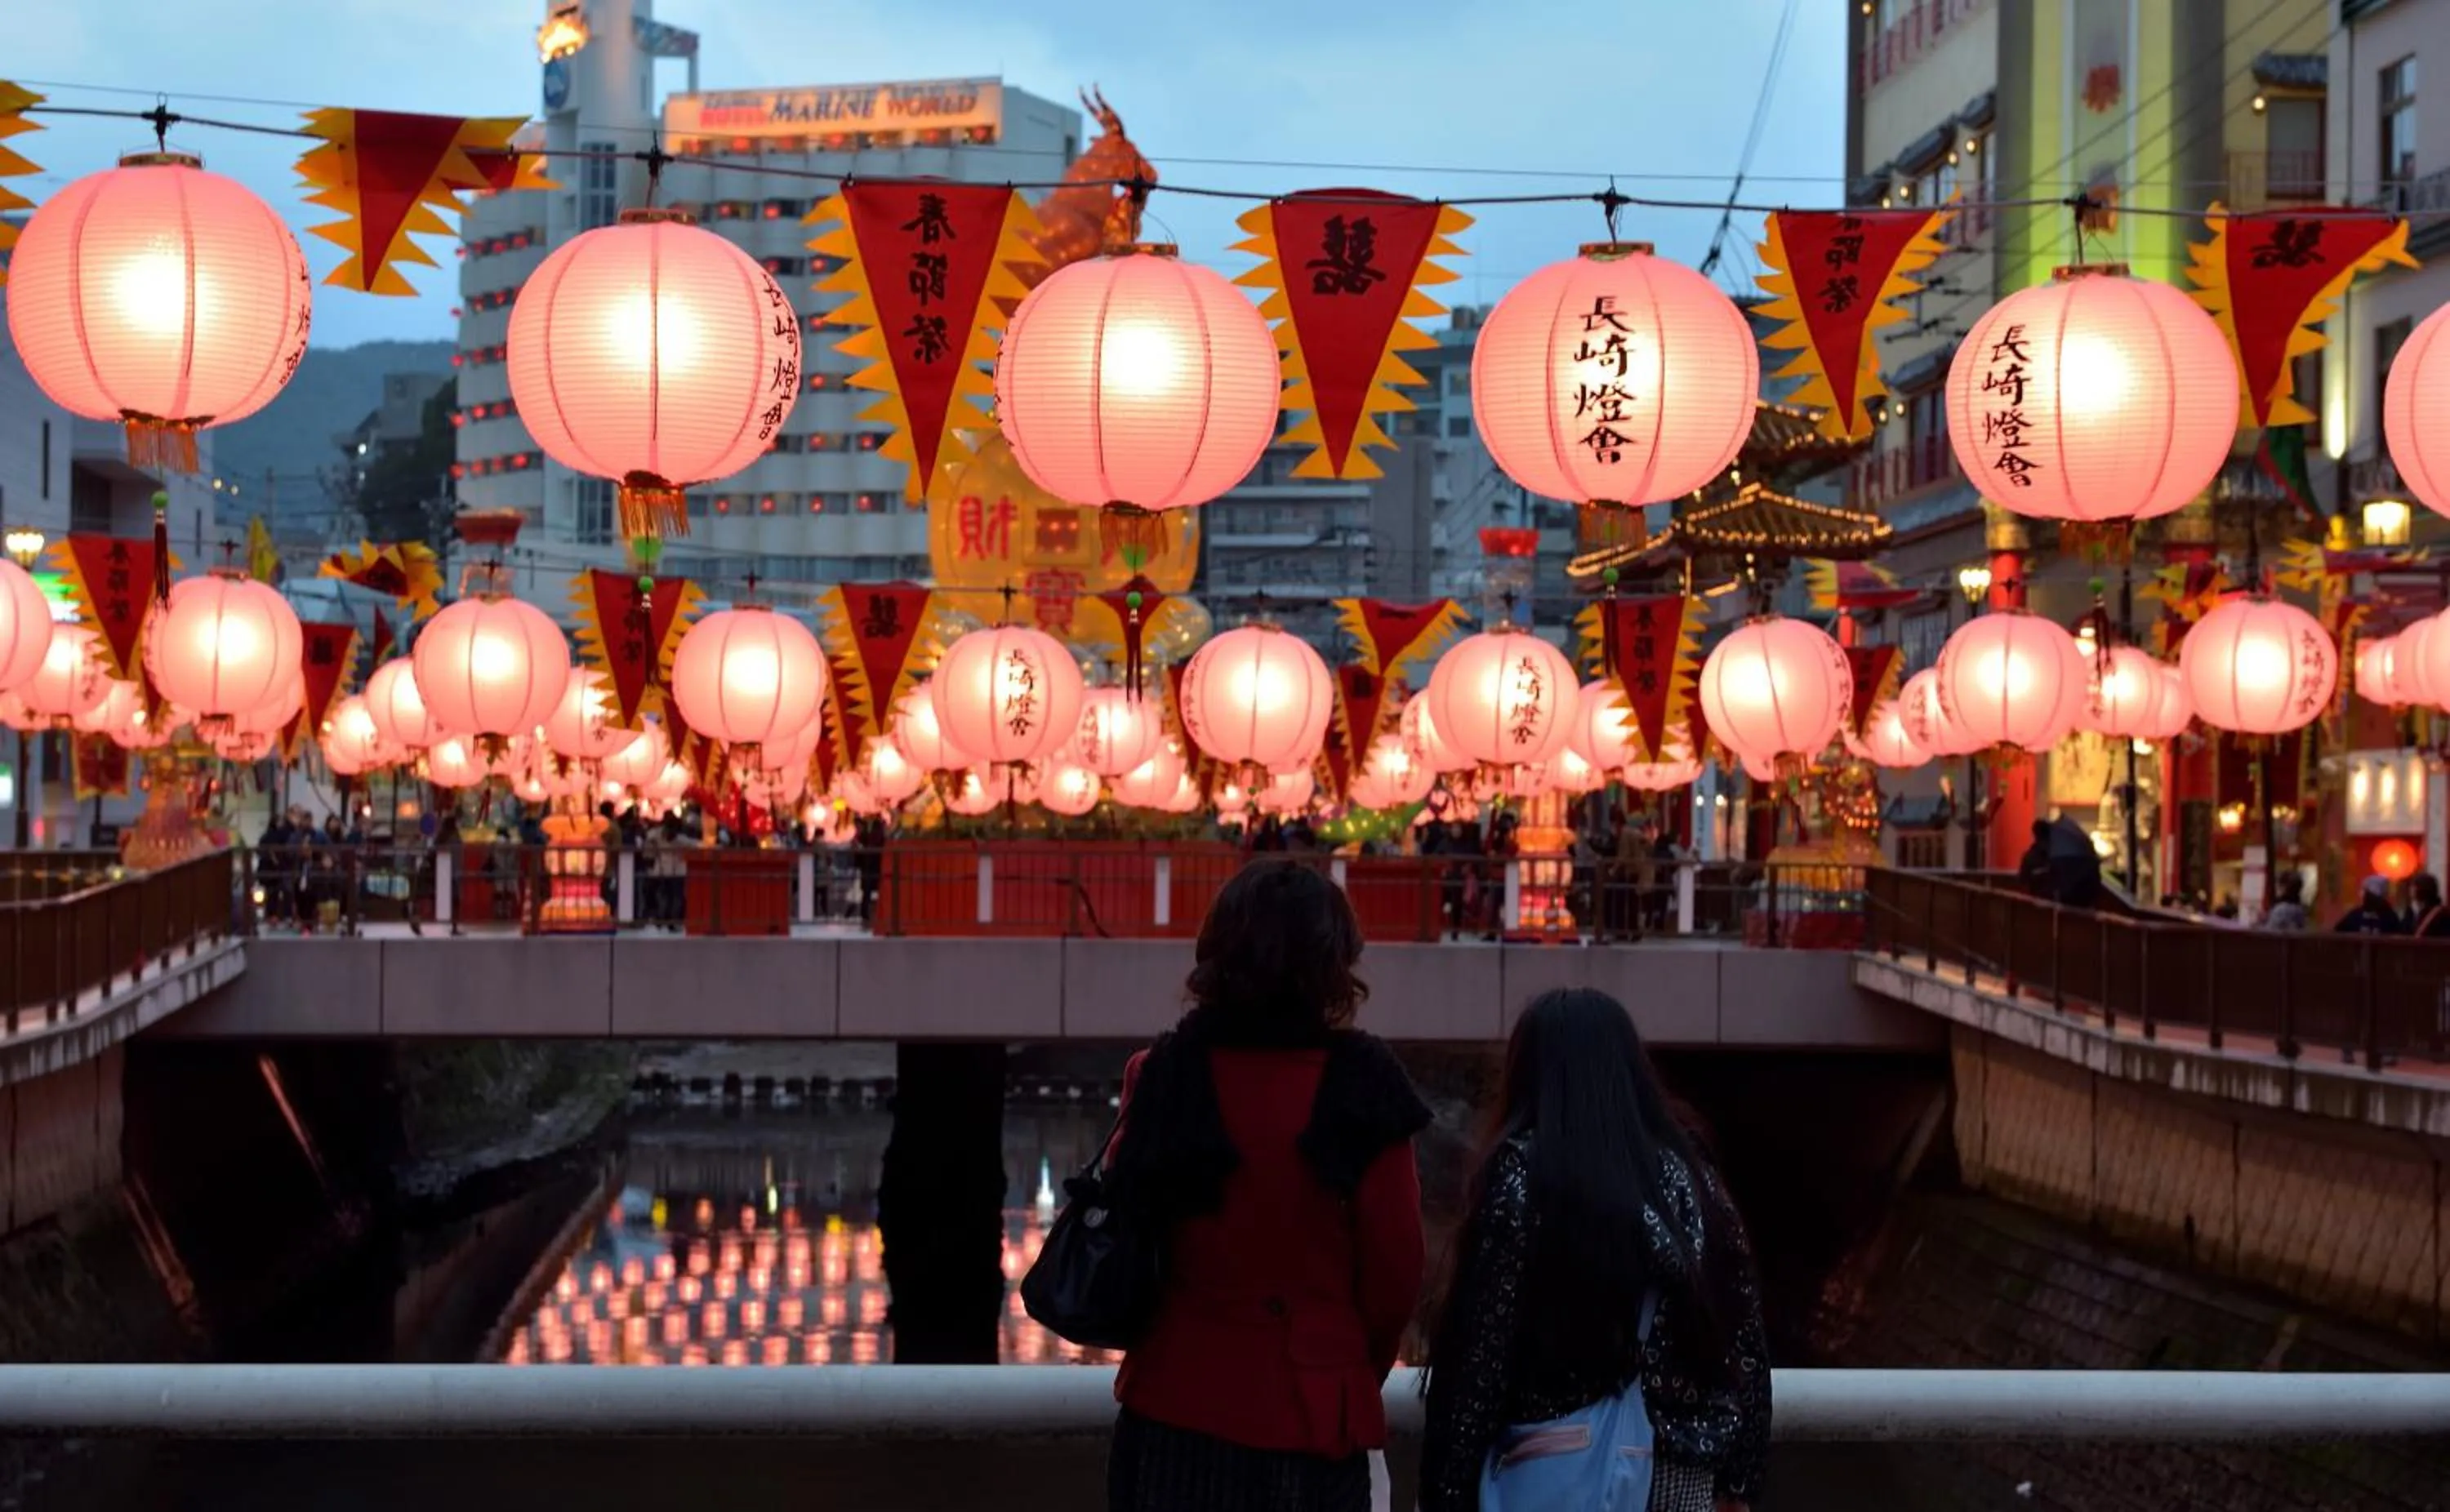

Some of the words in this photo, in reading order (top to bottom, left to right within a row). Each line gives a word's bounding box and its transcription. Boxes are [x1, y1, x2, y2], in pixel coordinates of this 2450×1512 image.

[769, 91, 877, 123] MARINE
[887, 96, 977, 118] WORLD
[959, 495, 1018, 562] 財
